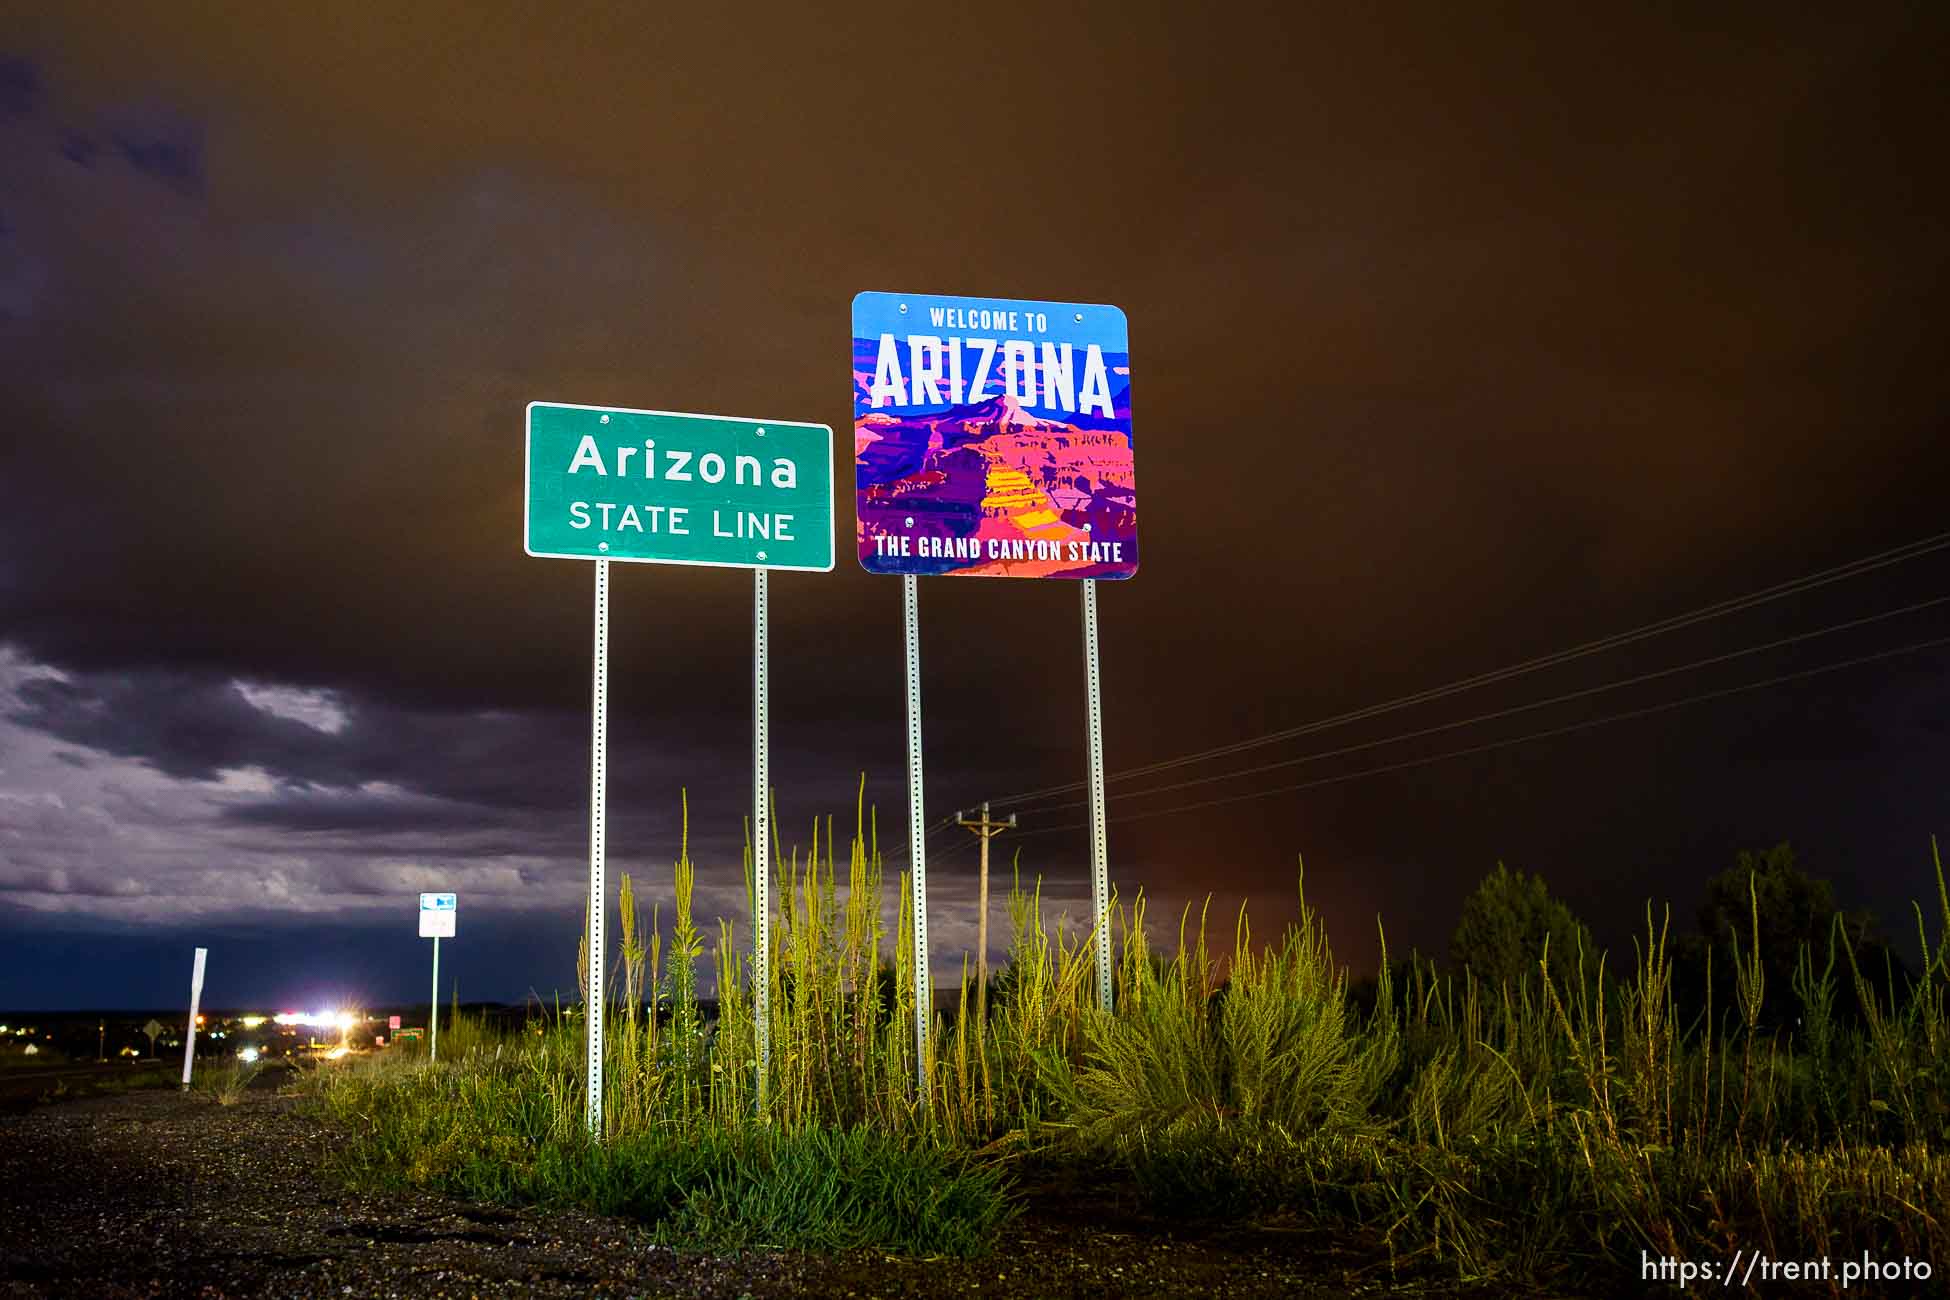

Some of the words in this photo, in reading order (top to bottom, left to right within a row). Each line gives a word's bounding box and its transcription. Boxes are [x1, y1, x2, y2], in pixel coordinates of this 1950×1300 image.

[930, 307, 1018, 331] WELCOME
[1025, 313, 1047, 333] TO
[871, 333, 1115, 418] ARIZONA
[568, 435, 797, 488] Arizona
[569, 501, 689, 535] STATE
[713, 510, 795, 541] LINE
[875, 535, 911, 557] THE
[918, 537, 981, 559] GRAND
[988, 540, 1061, 561] CANYON
[1069, 541, 1123, 563] STATE
